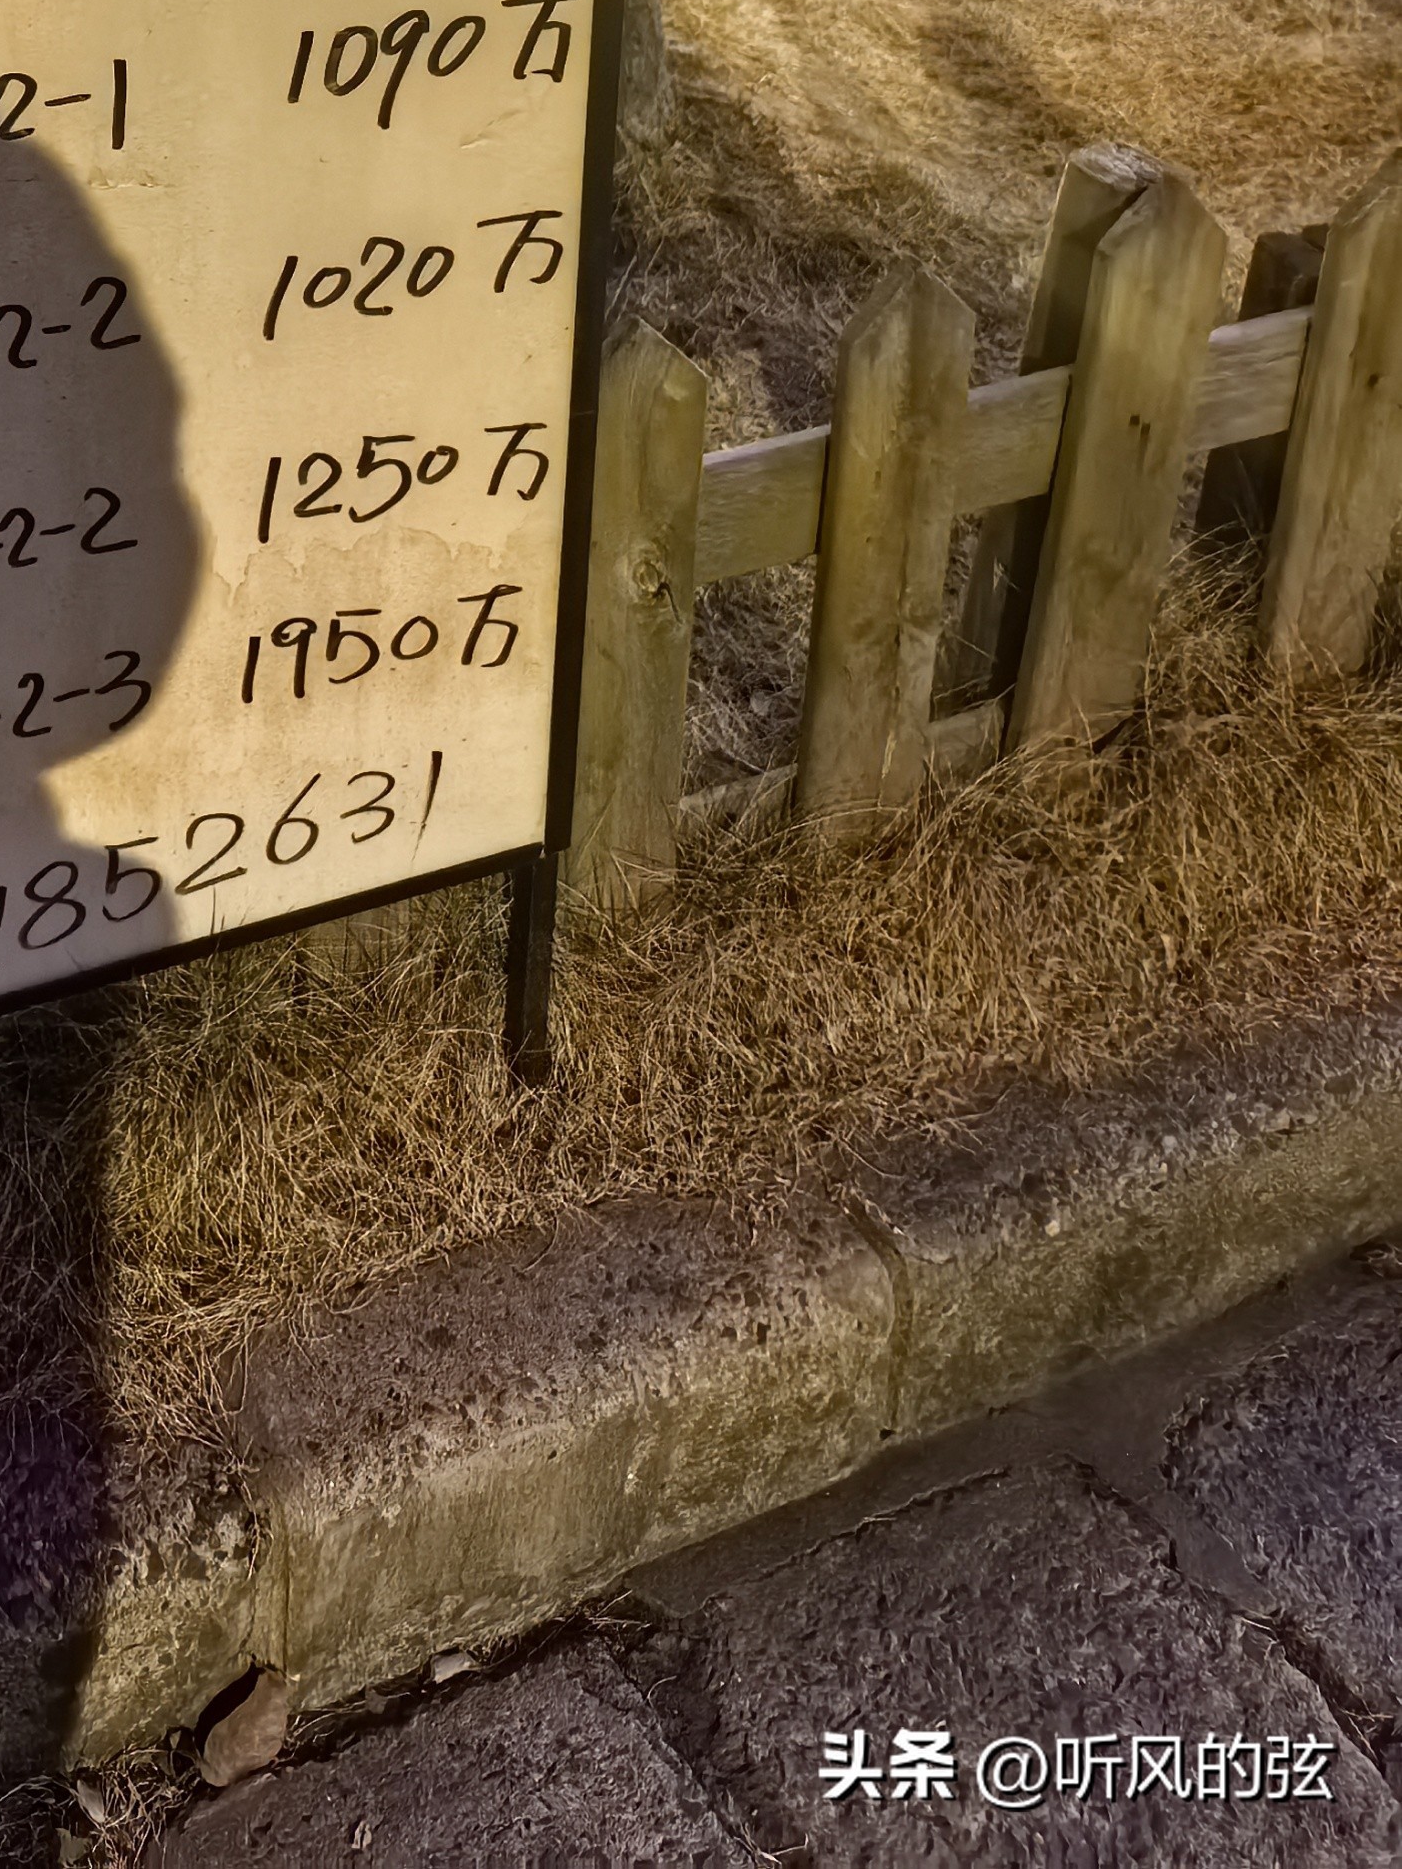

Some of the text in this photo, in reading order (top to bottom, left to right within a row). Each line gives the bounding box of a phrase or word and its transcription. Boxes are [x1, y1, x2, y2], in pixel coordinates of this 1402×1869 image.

[261, 209, 565, 342] 1020万
[256, 421, 551, 545] 1250万
[240, 582, 524, 705] 1950万
